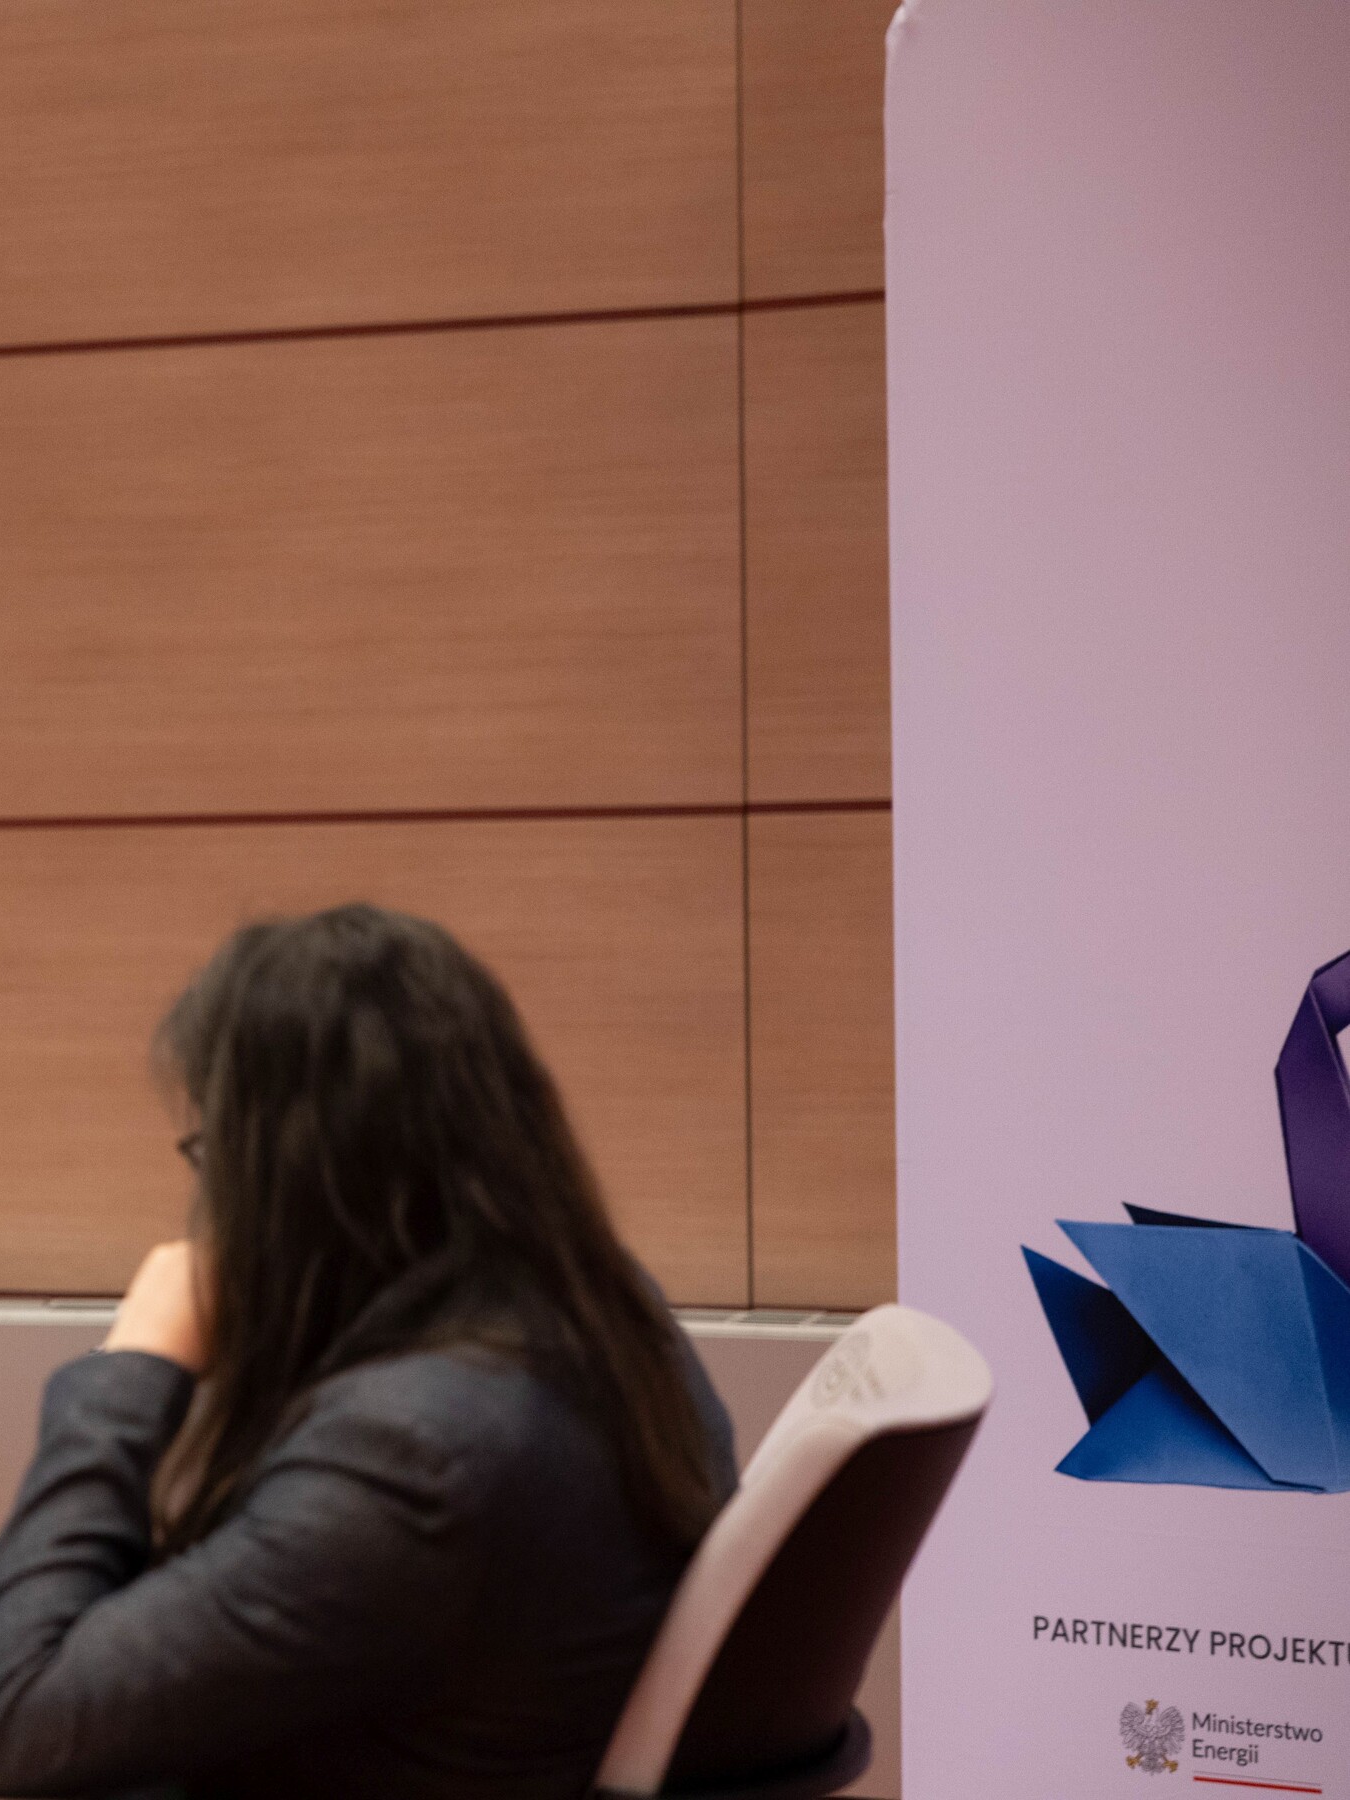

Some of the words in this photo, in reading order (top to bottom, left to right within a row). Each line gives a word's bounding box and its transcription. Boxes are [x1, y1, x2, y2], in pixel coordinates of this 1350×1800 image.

[1033, 1615, 1200, 1653] PARTNERZY
[1210, 1630, 1350, 1667] PROJEKT
[1192, 1712, 1323, 1743] Ministerstwo
[1192, 1739, 1259, 1766] Energii
